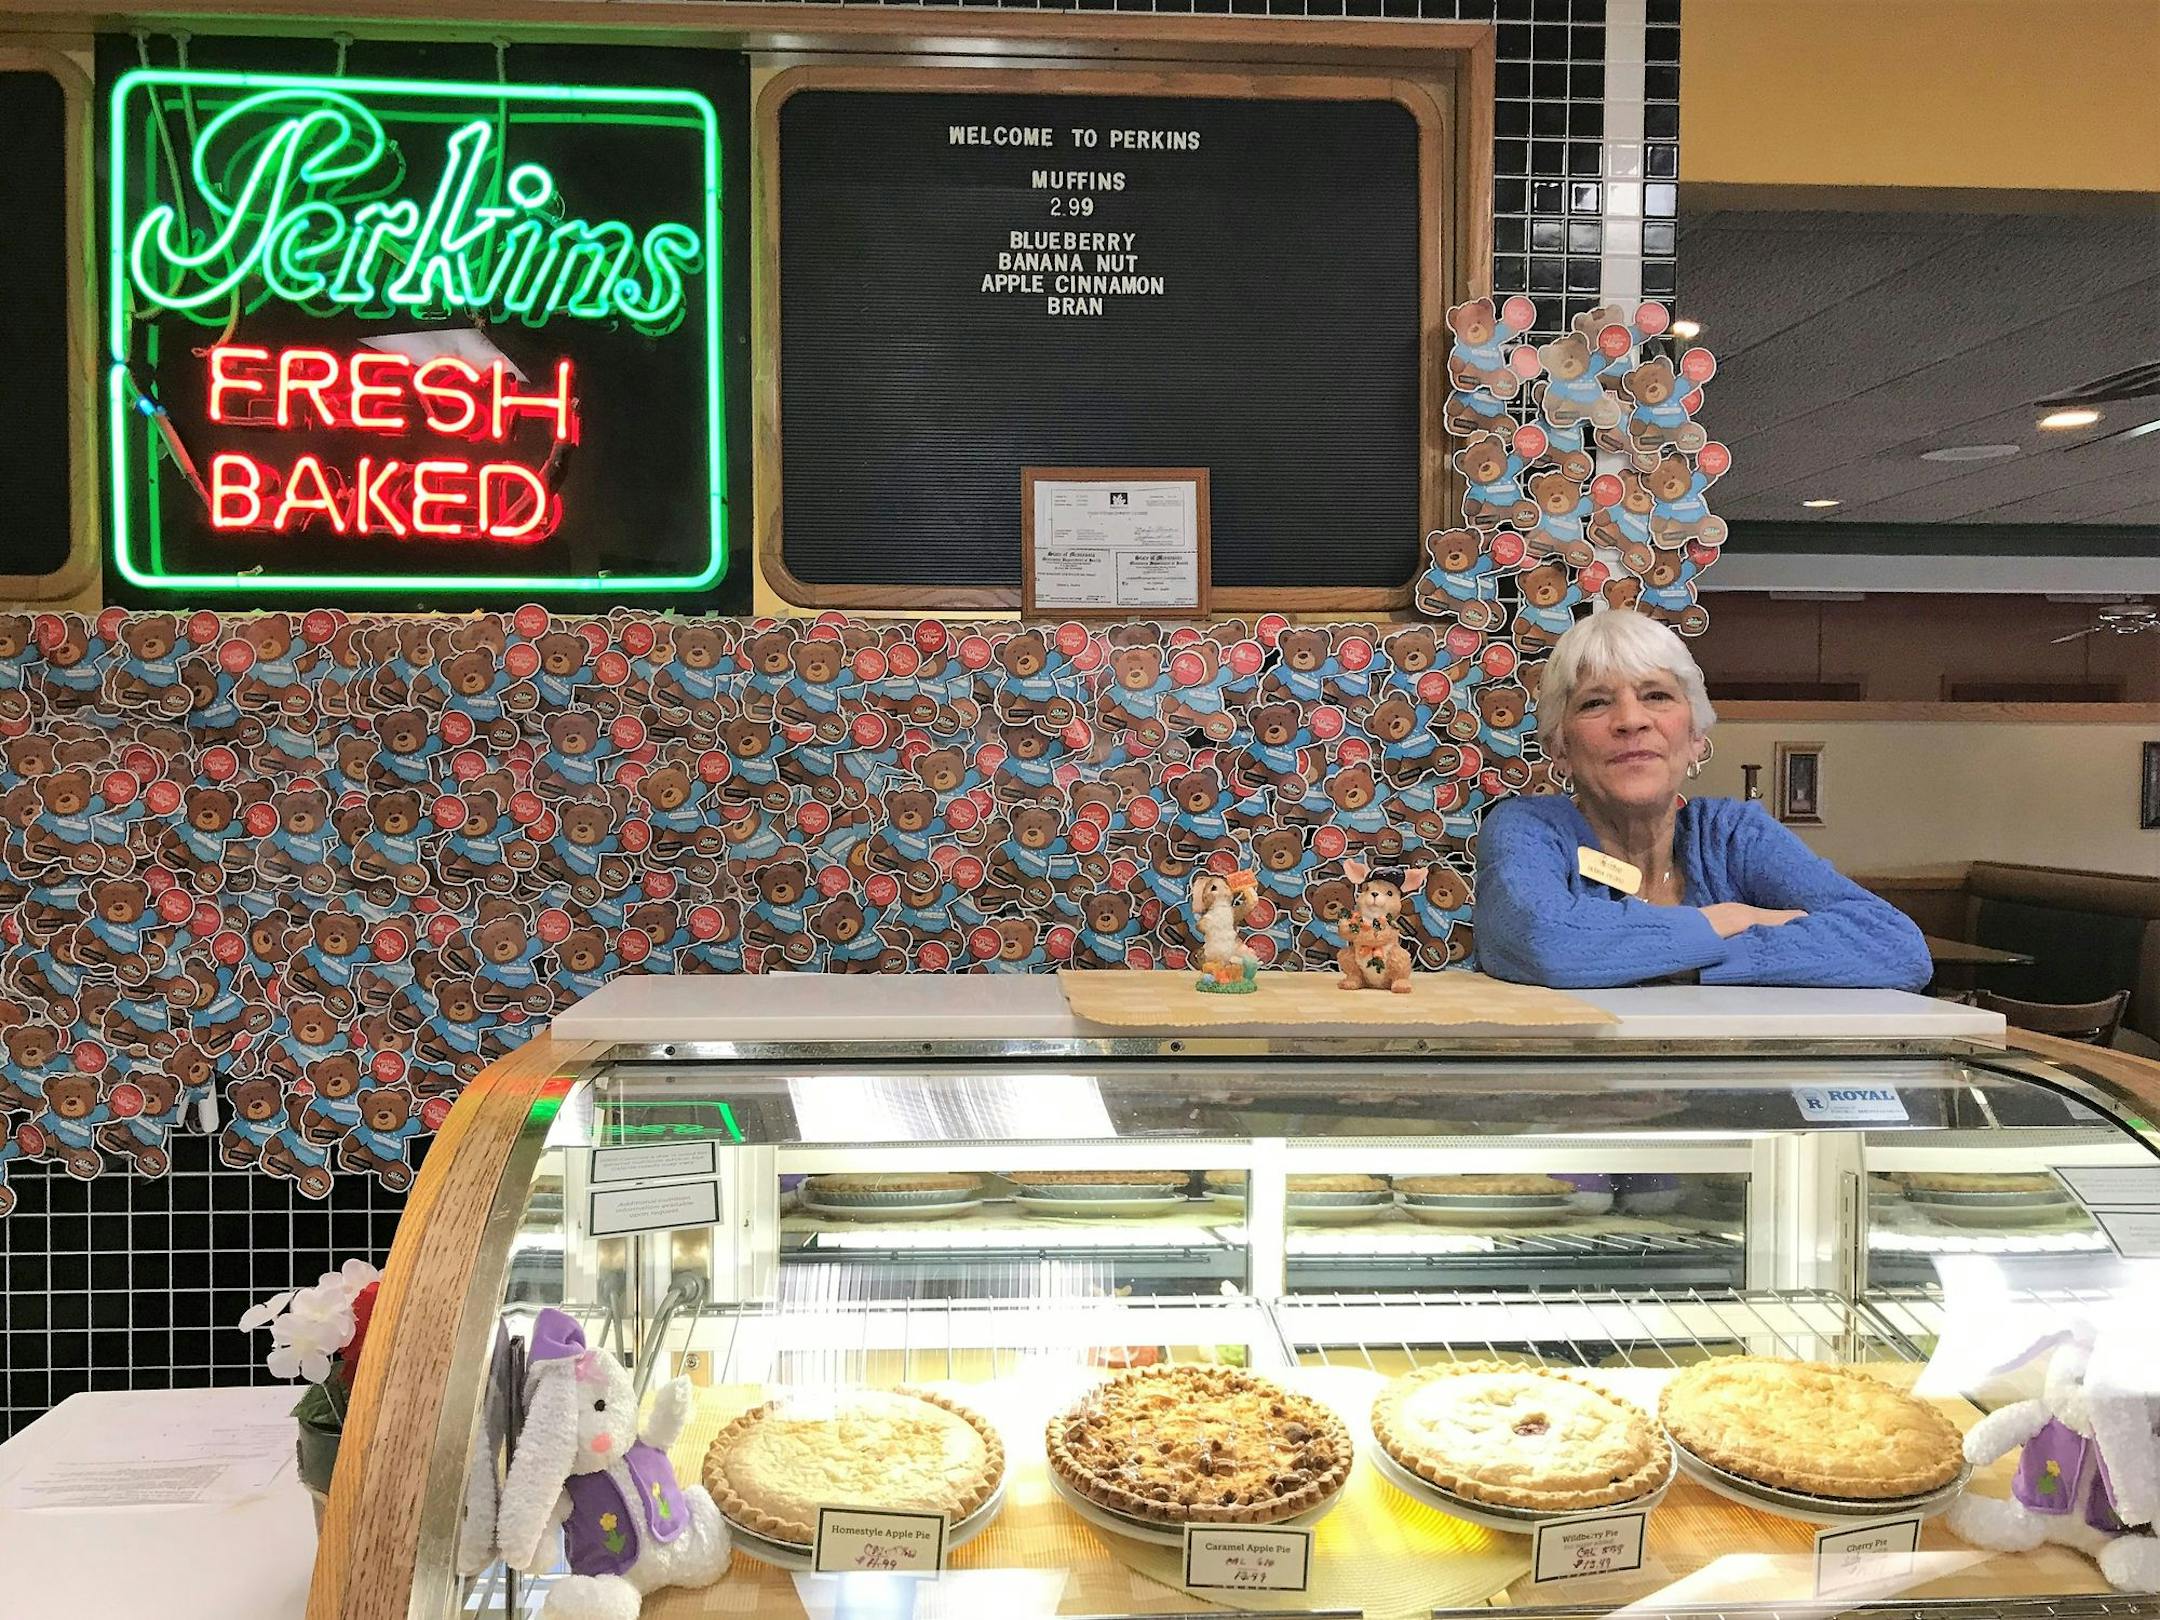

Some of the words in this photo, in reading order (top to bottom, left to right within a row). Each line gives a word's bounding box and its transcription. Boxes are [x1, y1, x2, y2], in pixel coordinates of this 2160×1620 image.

[949, 126, 1053, 147] WELCOME
[1072, 129, 1097, 148] TO
[1110, 130, 1201, 150] PERKINS
[1032, 170, 1126, 191] MUFFINS
[132, 90, 700, 321] Perkins
[1050, 197, 1094, 217] 2.99
[1010, 230, 1136, 251] BLUEBERRY
[998, 252, 1084, 272] BANANA
[1097, 254, 1138, 273] NUT
[981, 273, 1044, 294] APPLE
[1055, 275, 1164, 295] CINNAMON
[1048, 296, 1103, 316] BRAN
[207, 345, 575, 440] FRESH
[209, 452, 550, 539] BAKED
[1828, 1090, 1894, 1101] ROYAL
[831, 1525, 883, 1537] Homestyle
[885, 1529, 913, 1540] Apple
[915, 1531, 931, 1539] Pie
[1562, 1531, 1603, 1543] Wildberry
[1605, 1530, 1618, 1538] Pie
[1205, 1543, 1244, 1552] Caramel
[1246, 1544, 1274, 1554] Apple
[1276, 1545, 1291, 1553] Pie
[1846, 1541, 1874, 1553] Cherry
[1875, 1539, 1888, 1548] Pie
